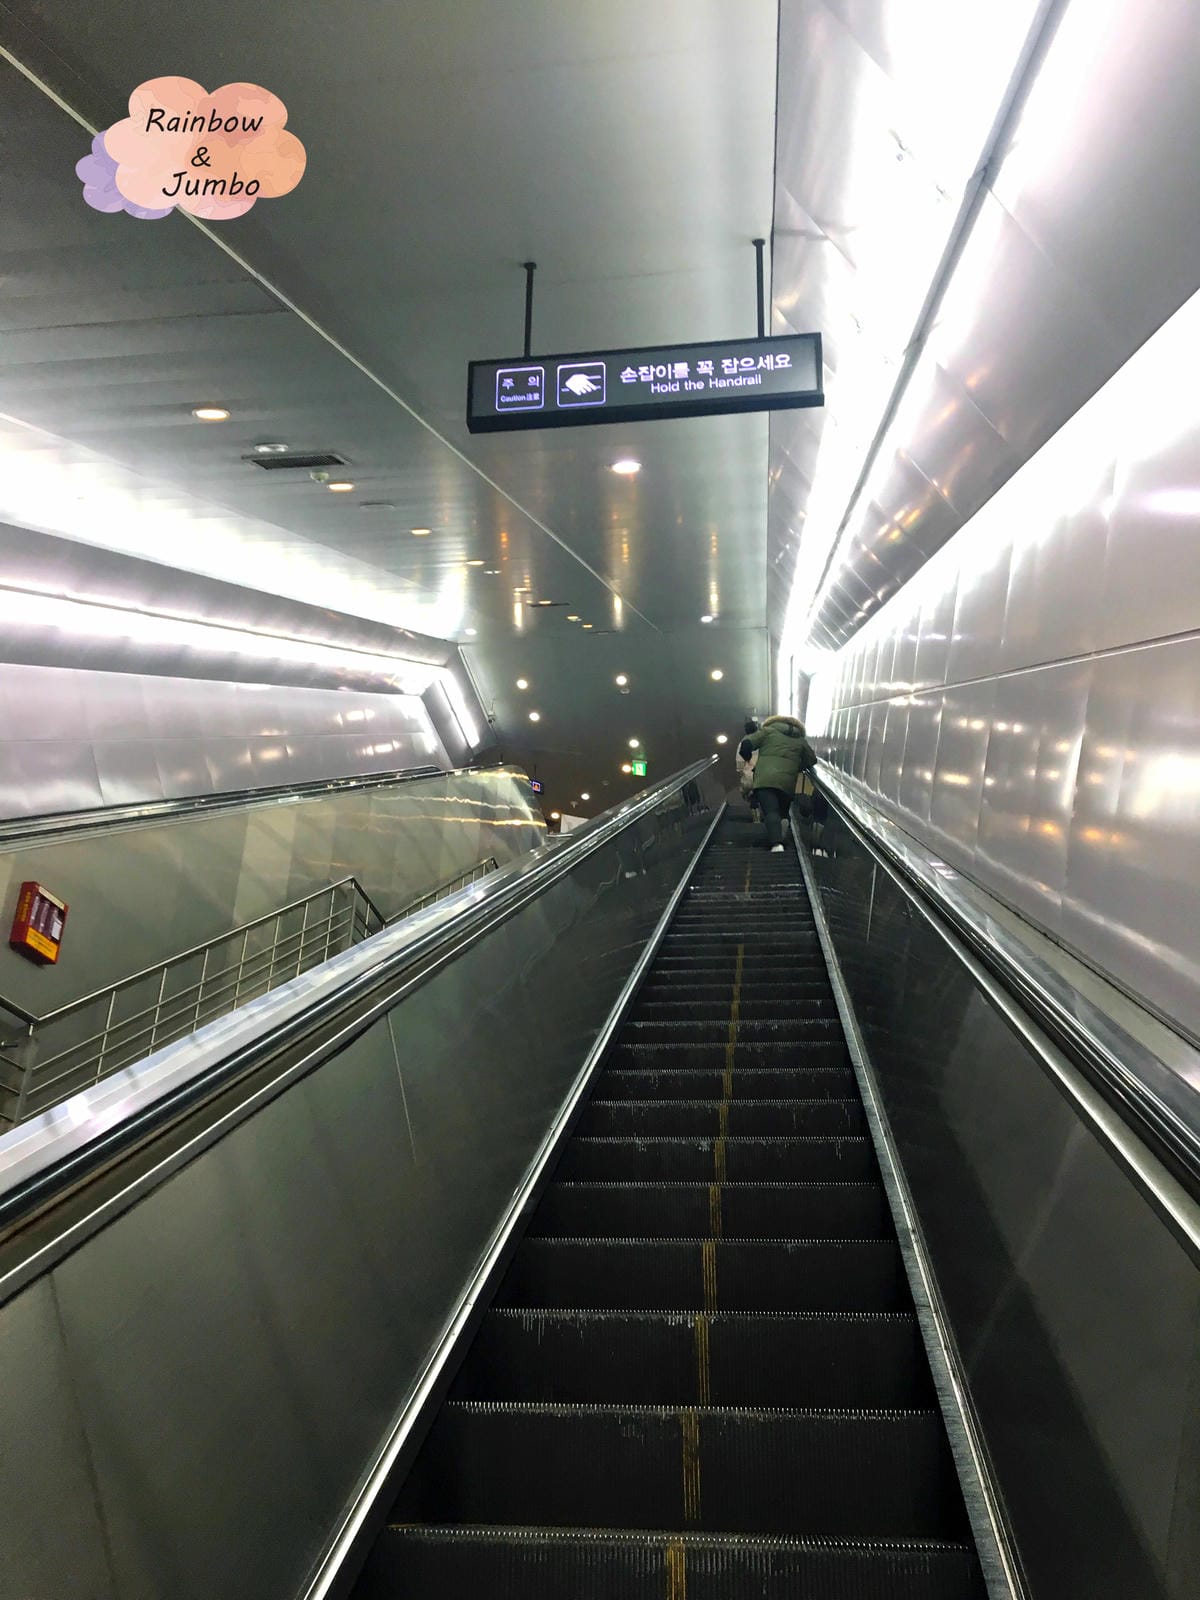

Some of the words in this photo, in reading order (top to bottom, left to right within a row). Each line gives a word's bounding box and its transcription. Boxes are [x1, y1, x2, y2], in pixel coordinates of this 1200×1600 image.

[620, 362, 690, 383] 손잡이를
[696, 360, 714, 376] 꼭
[721, 353, 793, 374] 잡으세요
[651, 381, 680, 393] Hold
[684, 379, 705, 391] the
[709, 374, 762, 389] Handrail
